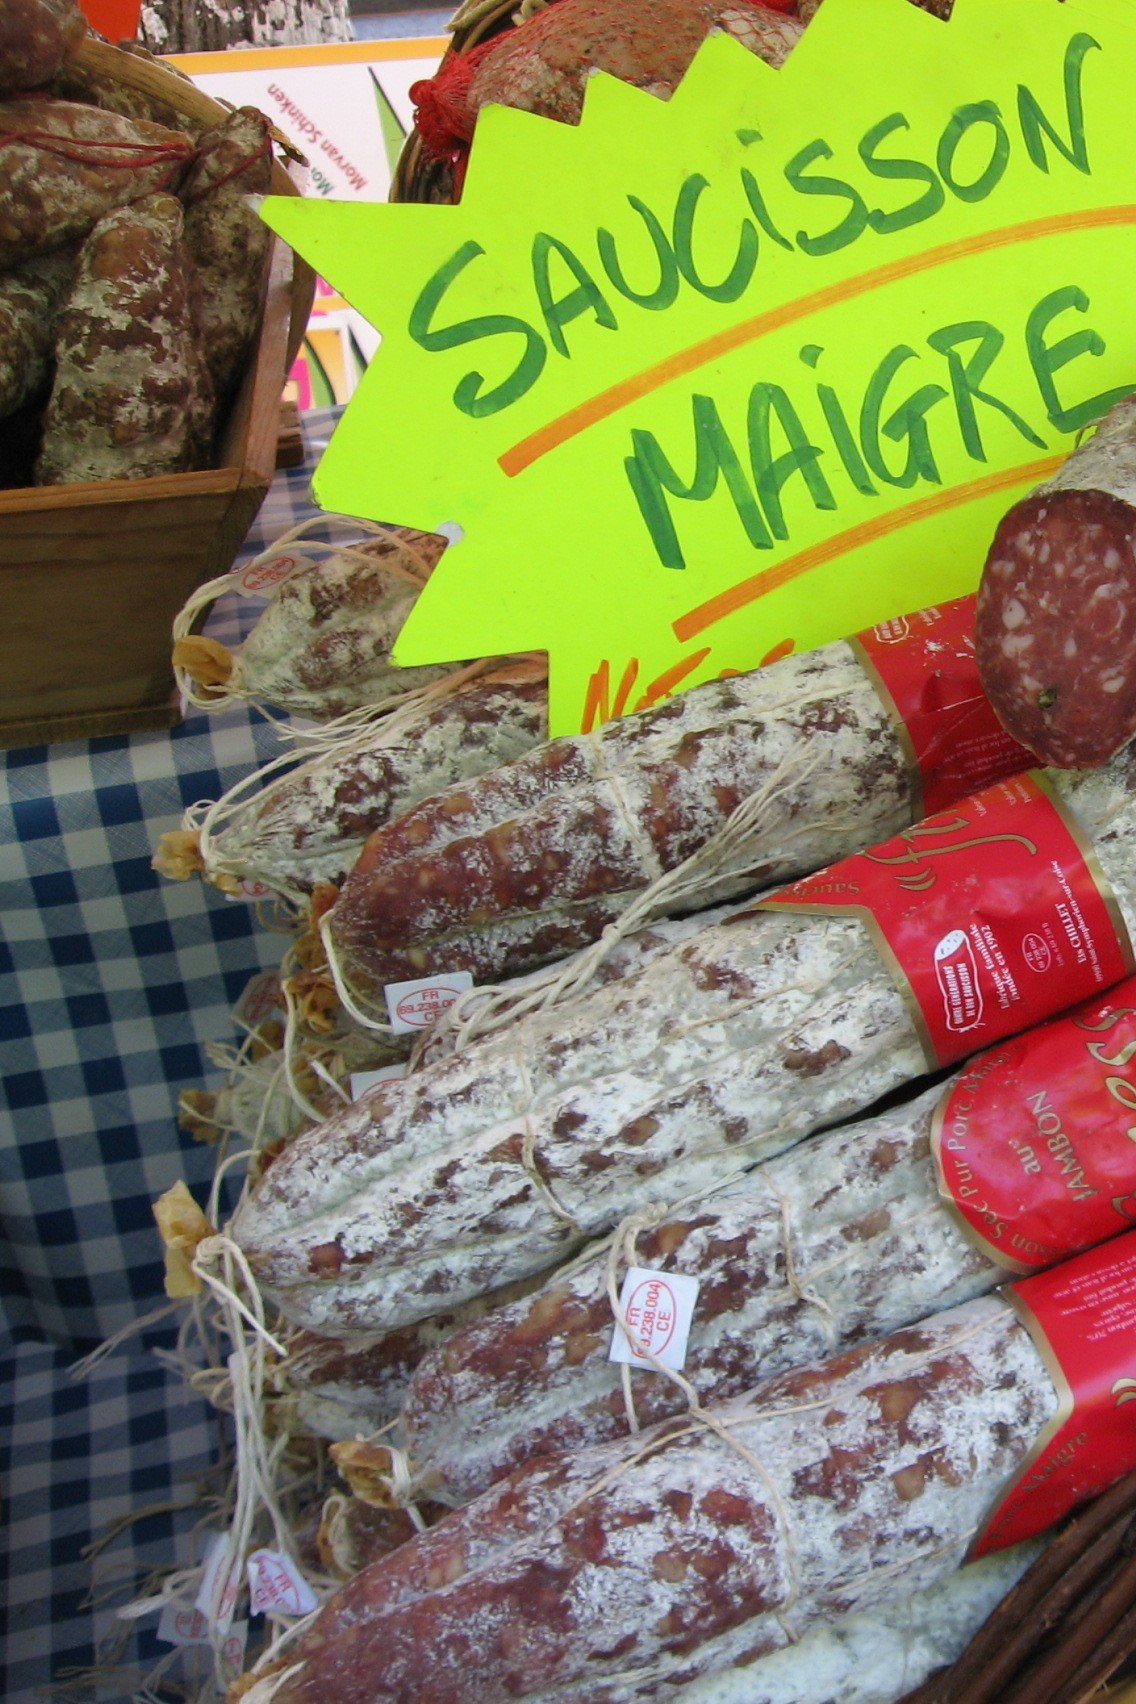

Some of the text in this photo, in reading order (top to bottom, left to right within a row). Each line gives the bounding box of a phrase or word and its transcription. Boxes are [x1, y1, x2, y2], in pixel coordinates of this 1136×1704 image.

[267, 84, 368, 191] Morvan Schinken
[981, 924, 997, 948] 1902
[1056, 902, 1080, 947] CHILLET
[969, 923, 993, 968] familiale
[995, 952, 1005, 965] en
[422, 990, 440, 1001] FR
[956, 962, 972, 997] SAUCISSON
[946, 1102, 974, 1151] Porc
[1025, 1089, 1094, 1203] JAMBON
[952, 1158, 979, 1199] Pur
[975, 1198, 1009, 1239] Sec
[629, 1307, 640, 1327] FR
[656, 1310, 671, 1332] CE
